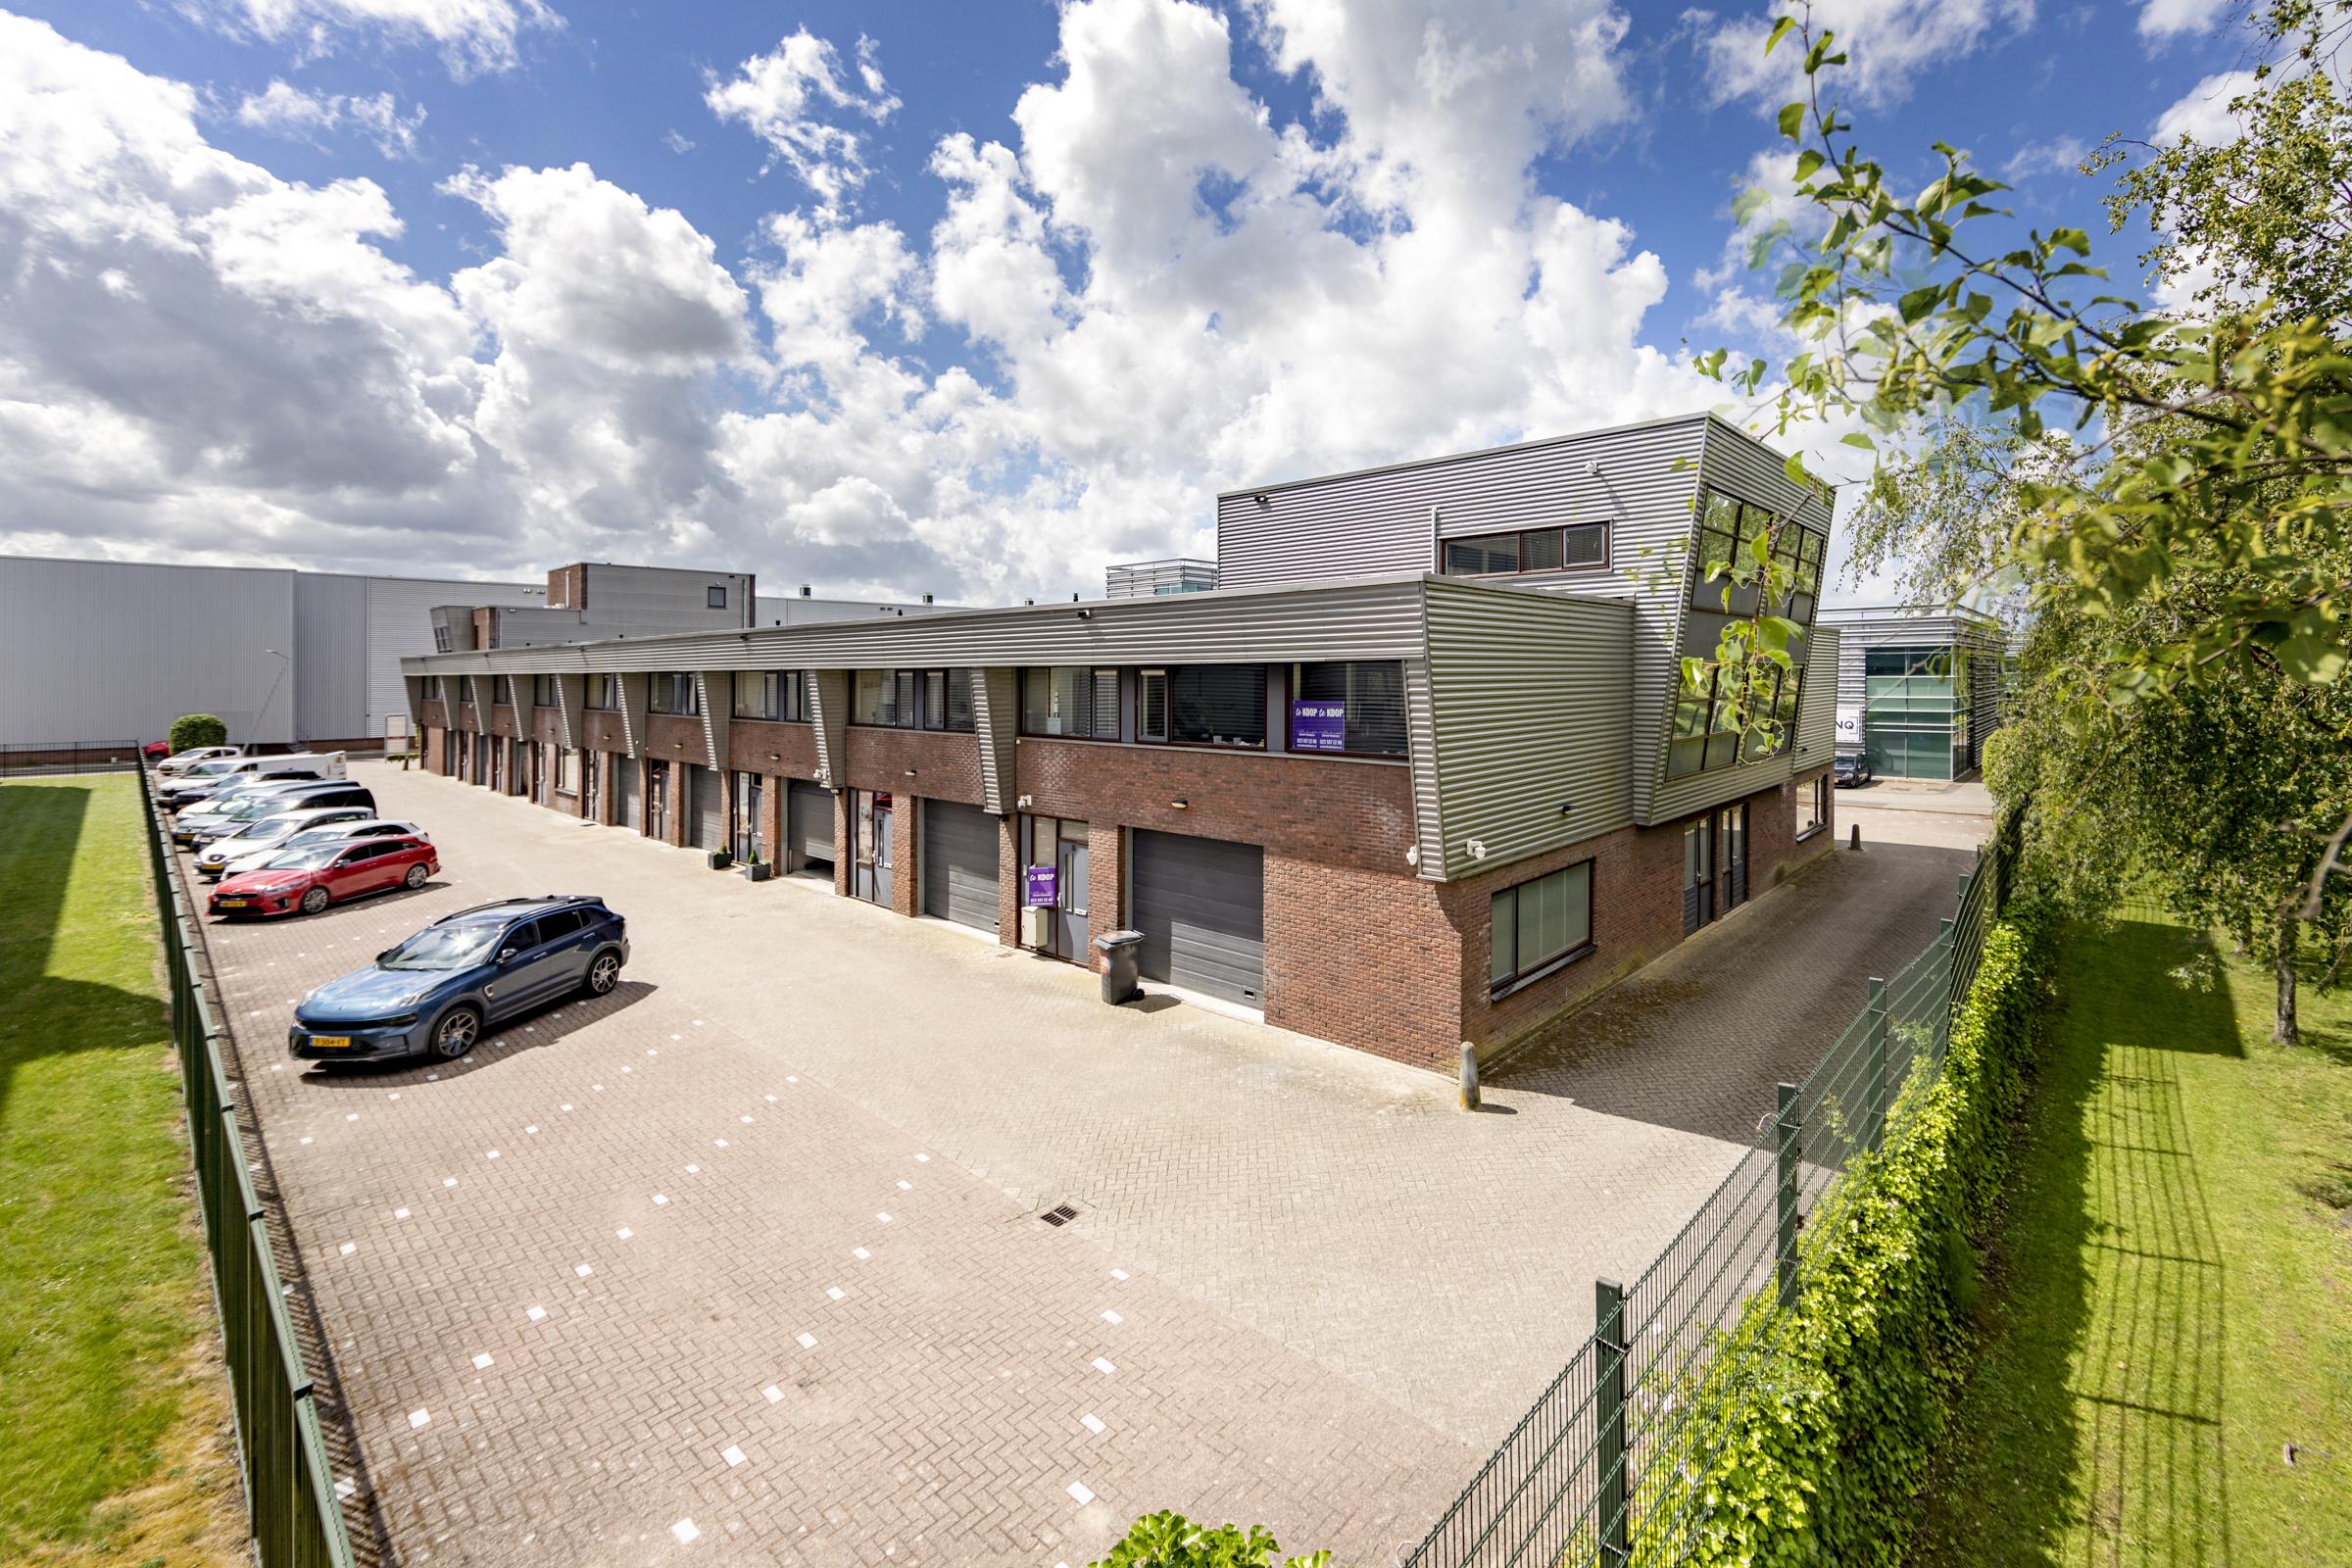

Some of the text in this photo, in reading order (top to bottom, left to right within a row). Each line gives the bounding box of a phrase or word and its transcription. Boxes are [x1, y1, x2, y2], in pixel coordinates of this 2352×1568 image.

[1296, 708, 1317, 716] te KOOP
[1319, 708, 1344, 717] te KOOP
